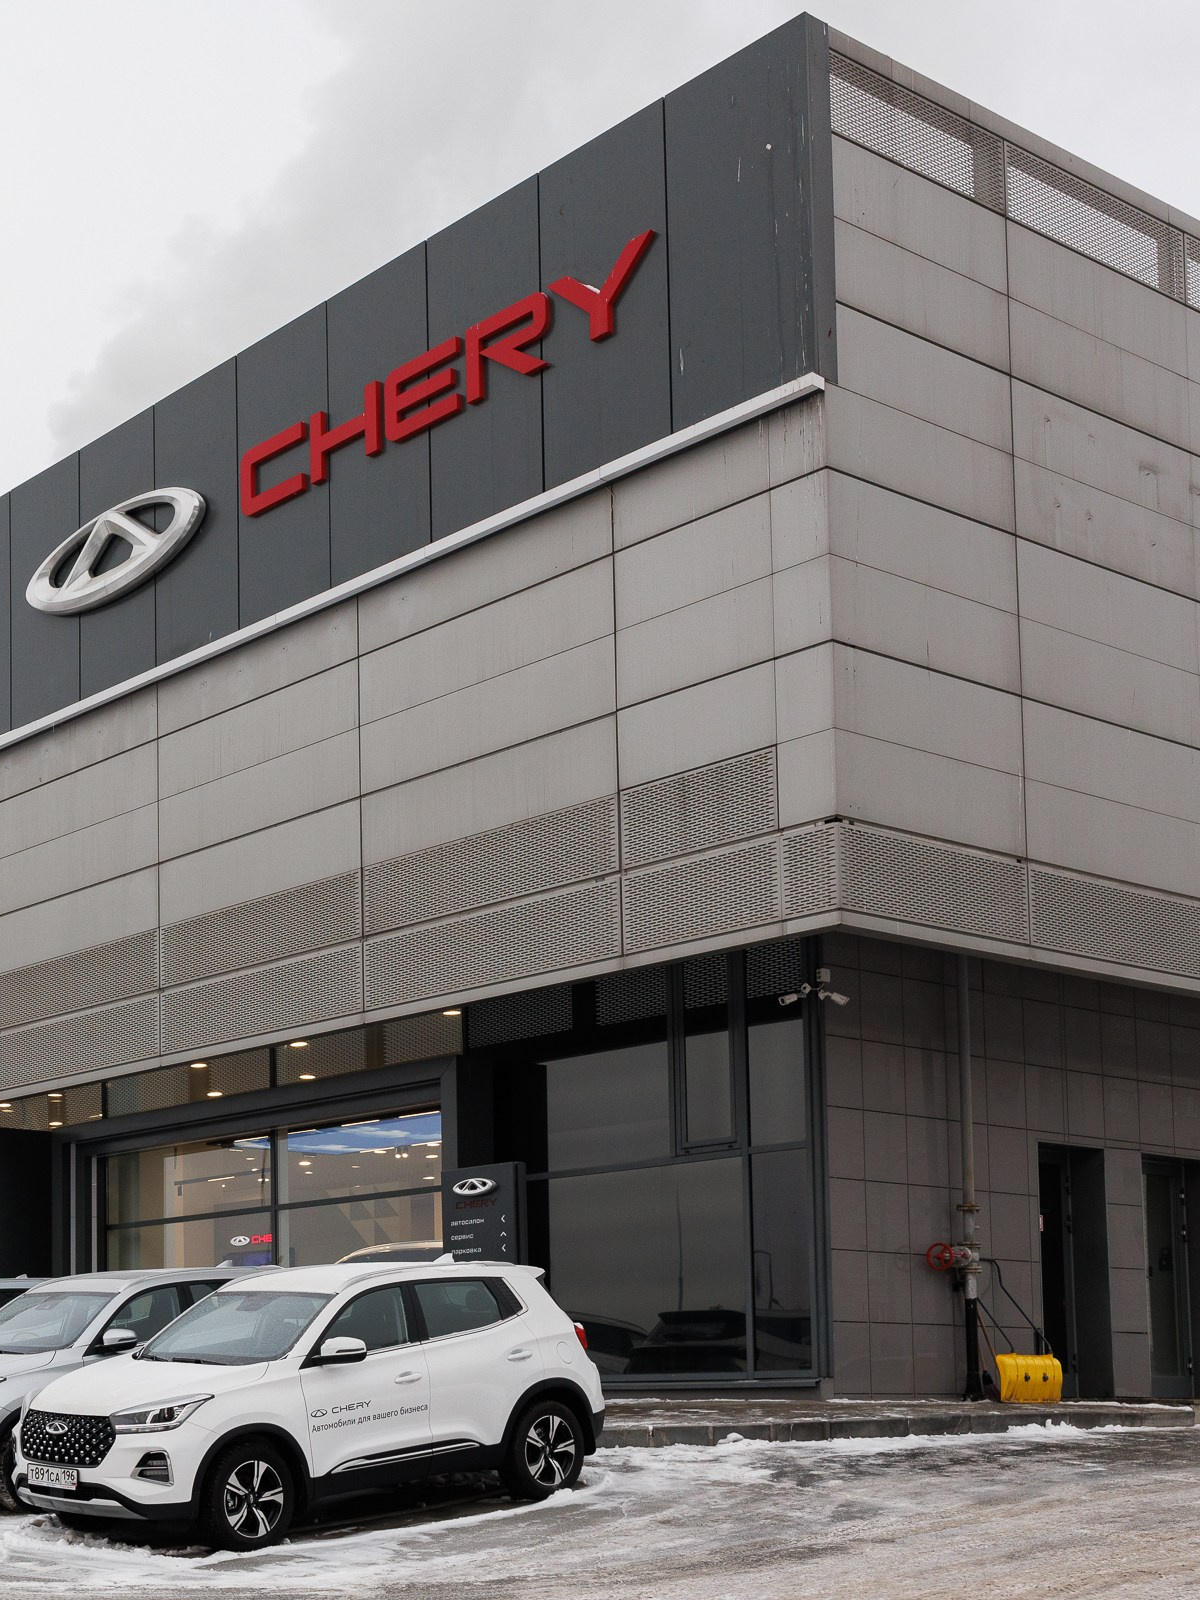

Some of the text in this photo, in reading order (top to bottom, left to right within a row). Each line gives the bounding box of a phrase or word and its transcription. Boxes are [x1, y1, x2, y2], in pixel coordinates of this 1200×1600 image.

[240, 229, 655, 517] CHERY
[455, 1197, 499, 1210] CHERY
[450, 1218, 485, 1227] автосалон
[251, 1233, 273, 1244] CHE
[450, 1233, 474, 1241] сервис
[451, 1247, 482, 1256] парковка
[331, 1400, 372, 1414] CHERY
[311, 1404, 429, 1433] Автомобили для вашего бизнеса
